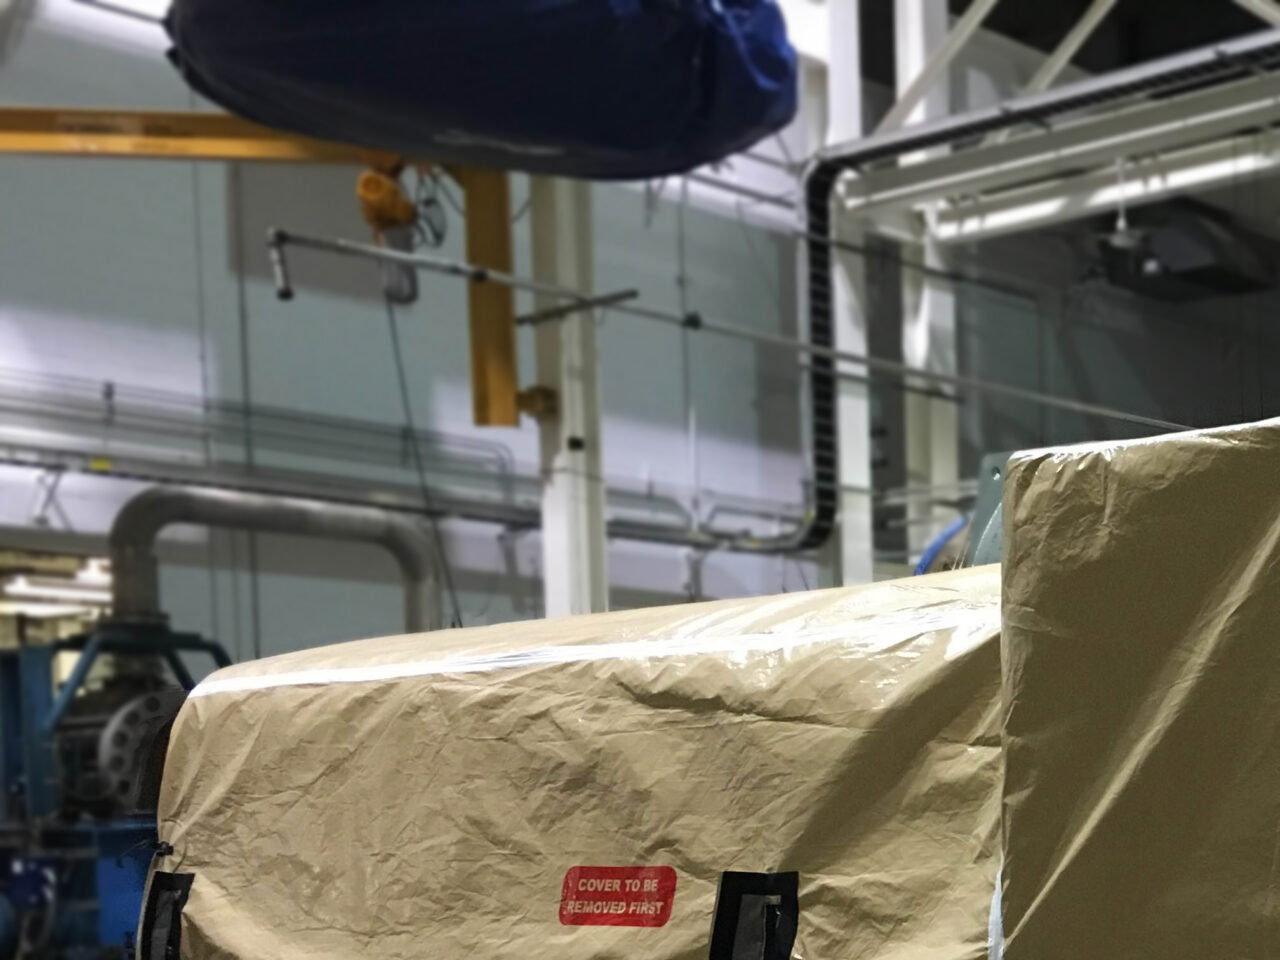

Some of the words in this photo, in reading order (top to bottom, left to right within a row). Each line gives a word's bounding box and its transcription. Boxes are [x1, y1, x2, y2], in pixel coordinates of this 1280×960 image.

[578, 879, 620, 891] COVER
[625, 879, 641, 892] TO
[643, 879, 658, 891] BE
[567, 901, 626, 914] REMOVED
[629, 902, 664, 914] FIRST
